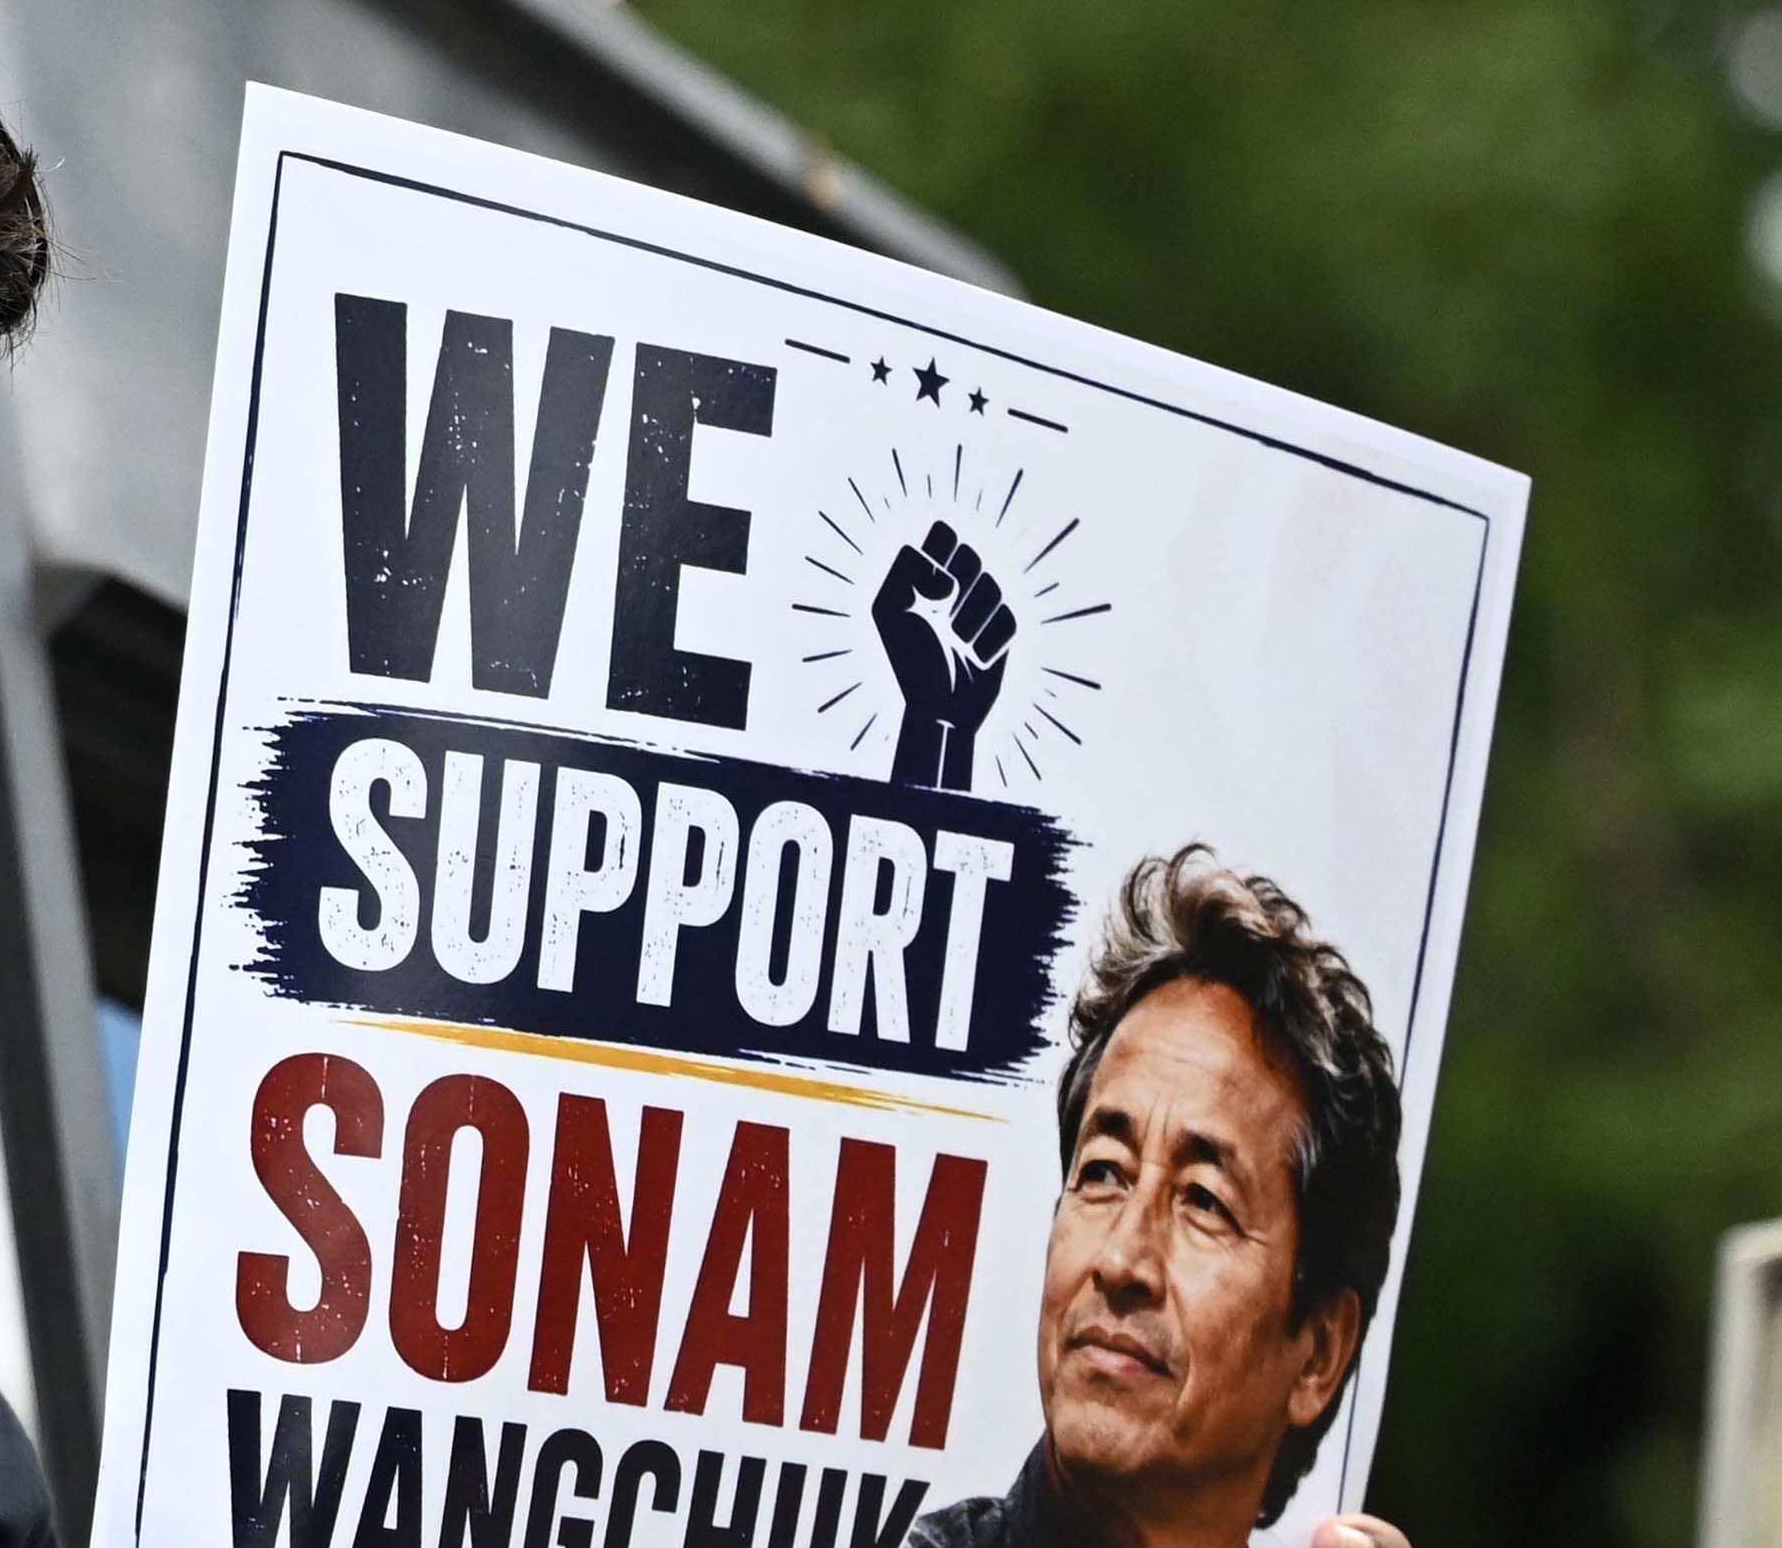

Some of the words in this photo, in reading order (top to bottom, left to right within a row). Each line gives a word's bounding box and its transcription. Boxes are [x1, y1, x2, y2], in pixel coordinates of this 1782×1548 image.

[334, 292, 777, 730] WE
[317, 737, 1013, 1051] SUPPORT
[236, 1051, 988, 1449] SONAM
